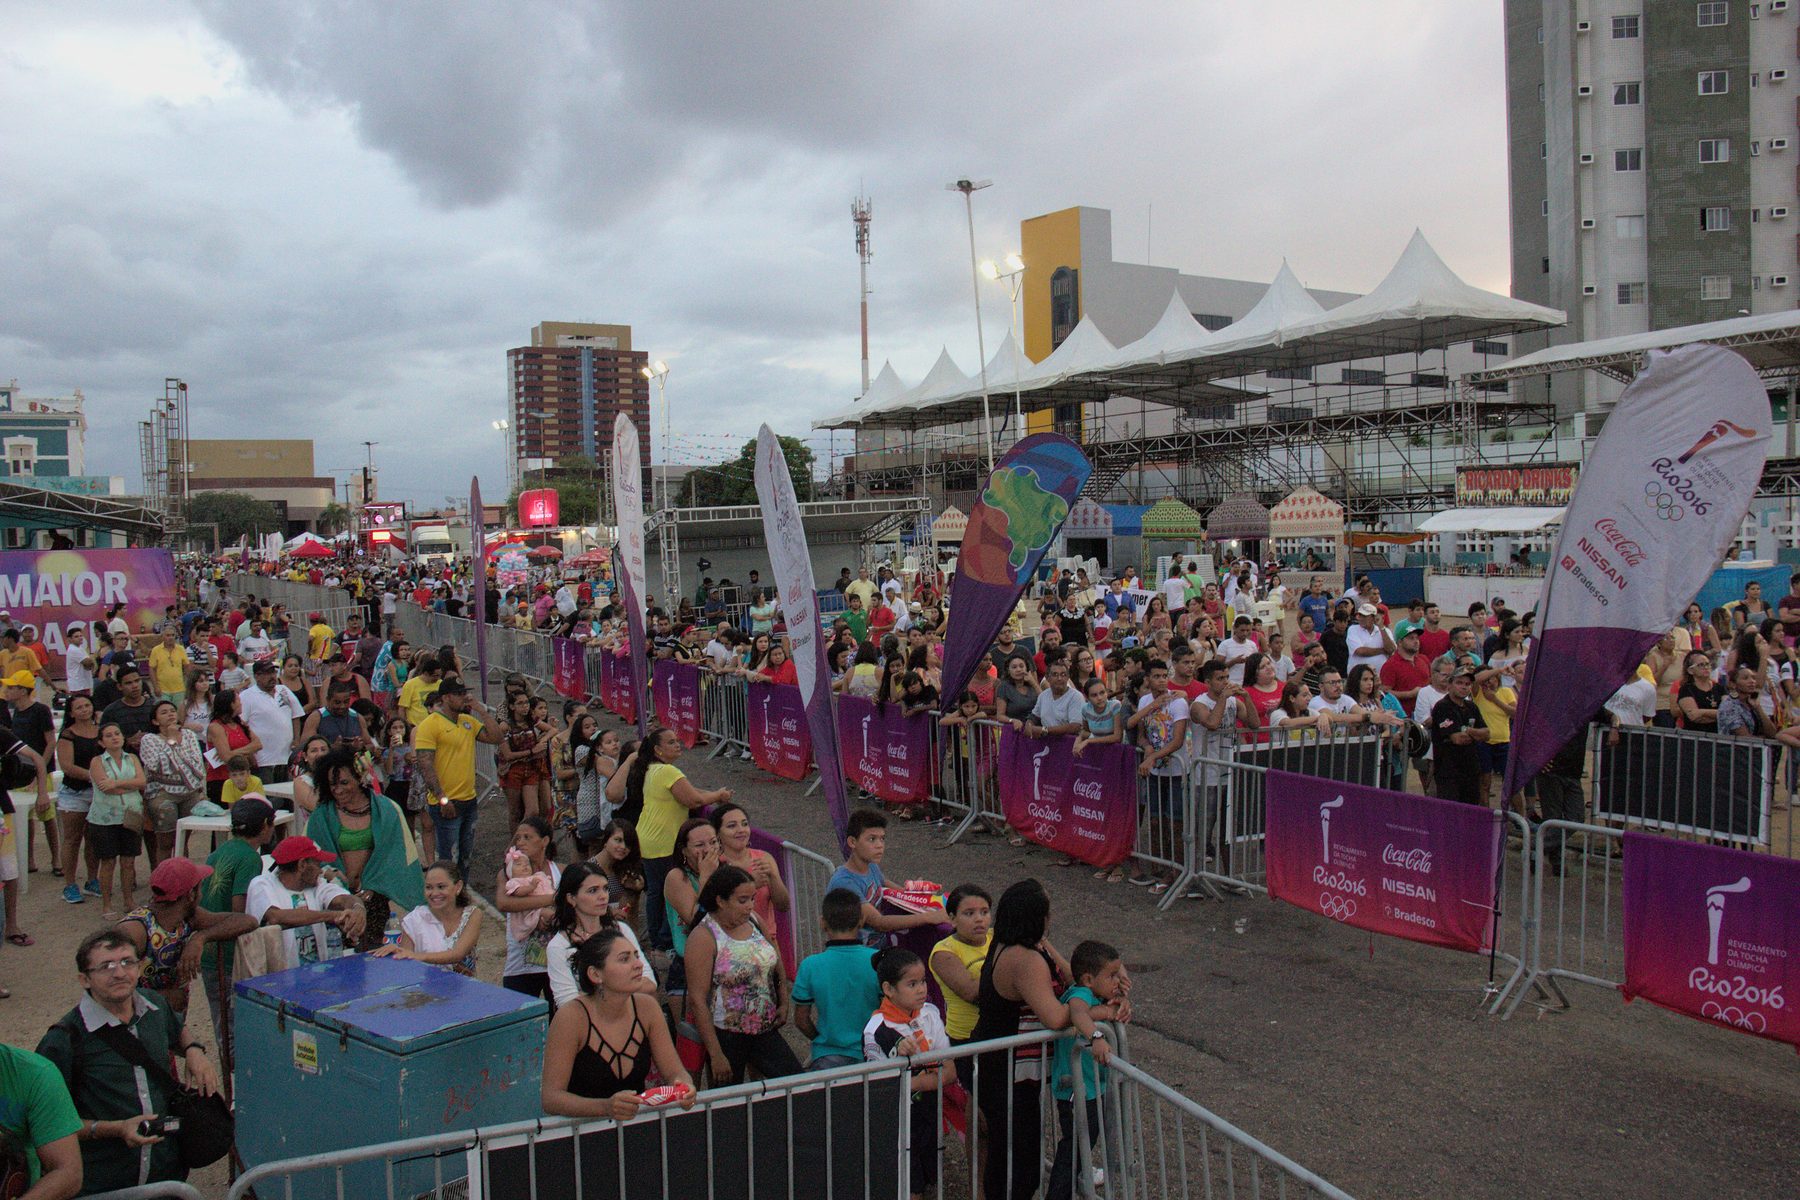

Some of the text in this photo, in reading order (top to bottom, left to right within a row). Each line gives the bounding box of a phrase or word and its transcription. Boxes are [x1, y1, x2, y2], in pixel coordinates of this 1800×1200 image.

[1465, 467, 1572, 491] RICARDO DRINKS
[1651, 457, 1713, 516] Rio2016
[1577, 536, 1628, 591] NISSAN
[0, 570, 129, 608] MAIOR
[1571, 566, 1609, 606] Bradesco
[888, 765, 910, 778] NISSAN
[1027, 802, 1063, 822] Rio2016
[1072, 804, 1105, 822] NISSAN
[1078, 827, 1106, 841] Bradesco
[1382, 842, 1433, 874] Coca-Cola
[1312, 865, 1367, 896] Rio2016
[1382, 876, 1437, 903] NISSAN
[896, 891, 928, 904] Bradesco
[1394, 907, 1436, 928] Bradesco
[1727, 938, 1788, 958] REVEZAMENTO
[1727, 948, 1769, 964] DA TOCHA
[1726, 958, 1767, 974] OLÍMPICA
[1689, 966, 1786, 1009] Rio2016
